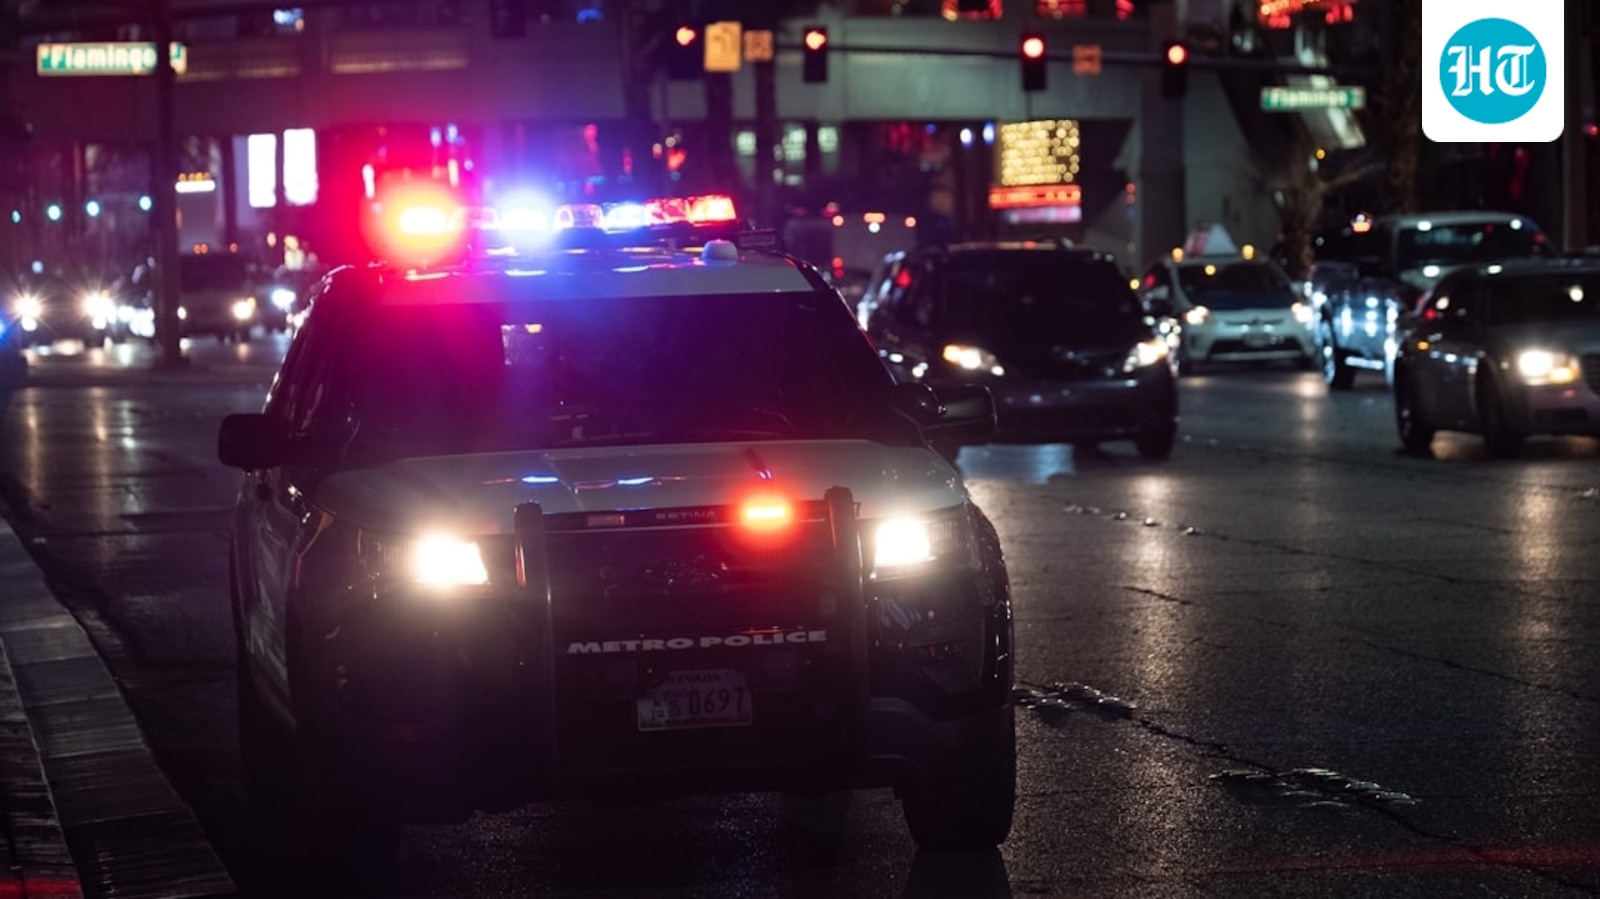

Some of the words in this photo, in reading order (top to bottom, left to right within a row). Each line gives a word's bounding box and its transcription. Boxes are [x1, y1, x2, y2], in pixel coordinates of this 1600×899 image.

[51, 45, 157, 74] Flamingo
[1270, 88, 1347, 110] Flamingo
[568, 638, 694, 655] METRO
[699, 630, 828, 649] POLICE
[667, 672, 722, 685] NEVADA
[688, 686, 744, 717] 0697
